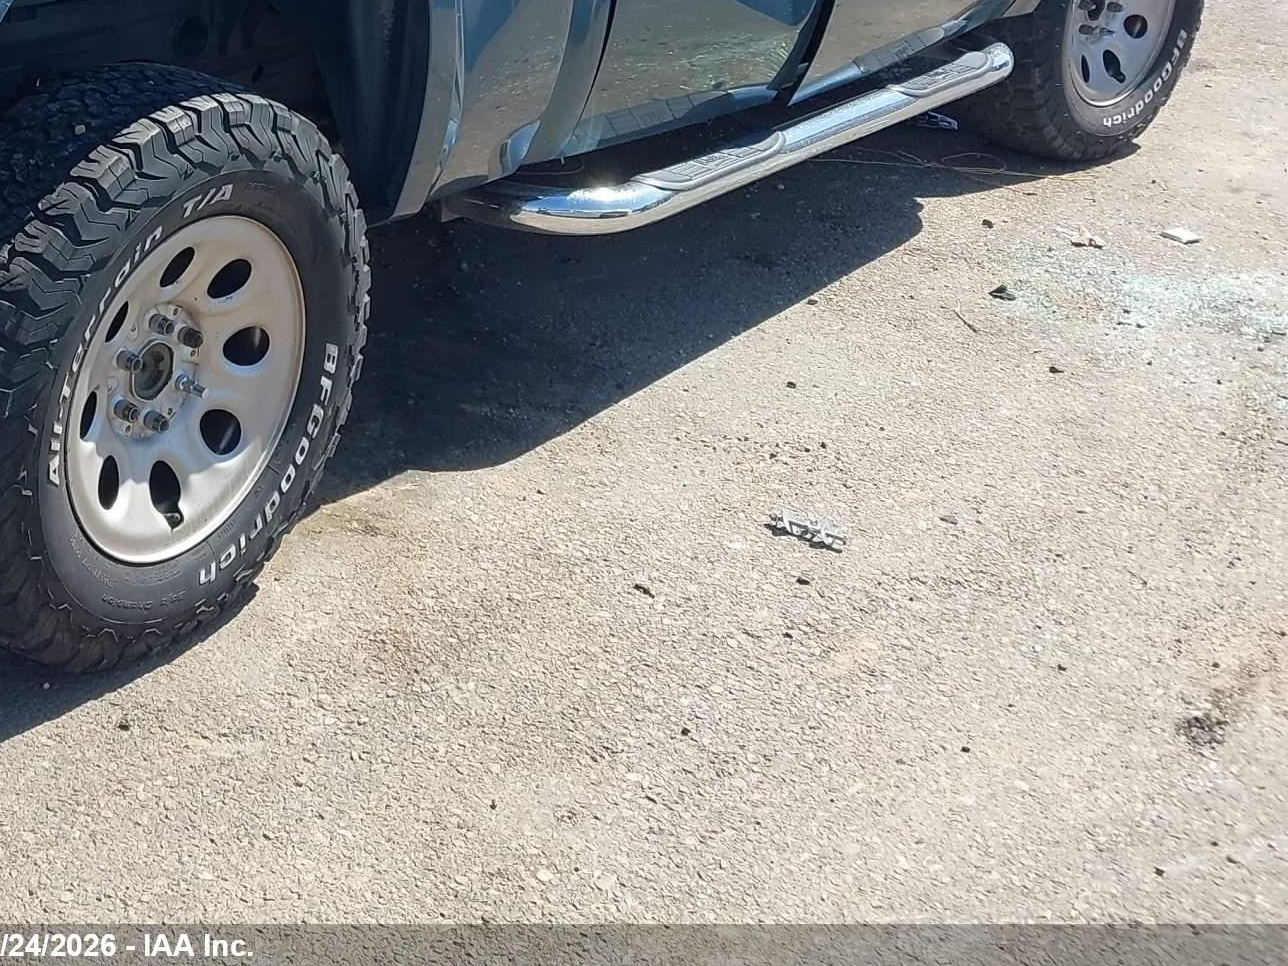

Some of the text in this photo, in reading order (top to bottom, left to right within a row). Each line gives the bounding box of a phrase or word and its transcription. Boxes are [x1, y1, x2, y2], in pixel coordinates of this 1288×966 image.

[1103, 28, 1187, 127] BFGoodrich
[48, 225, 163, 486] All-Terrain
[182, 183, 234, 219] T/A
[198, 342, 339, 585] BFGoodrich
